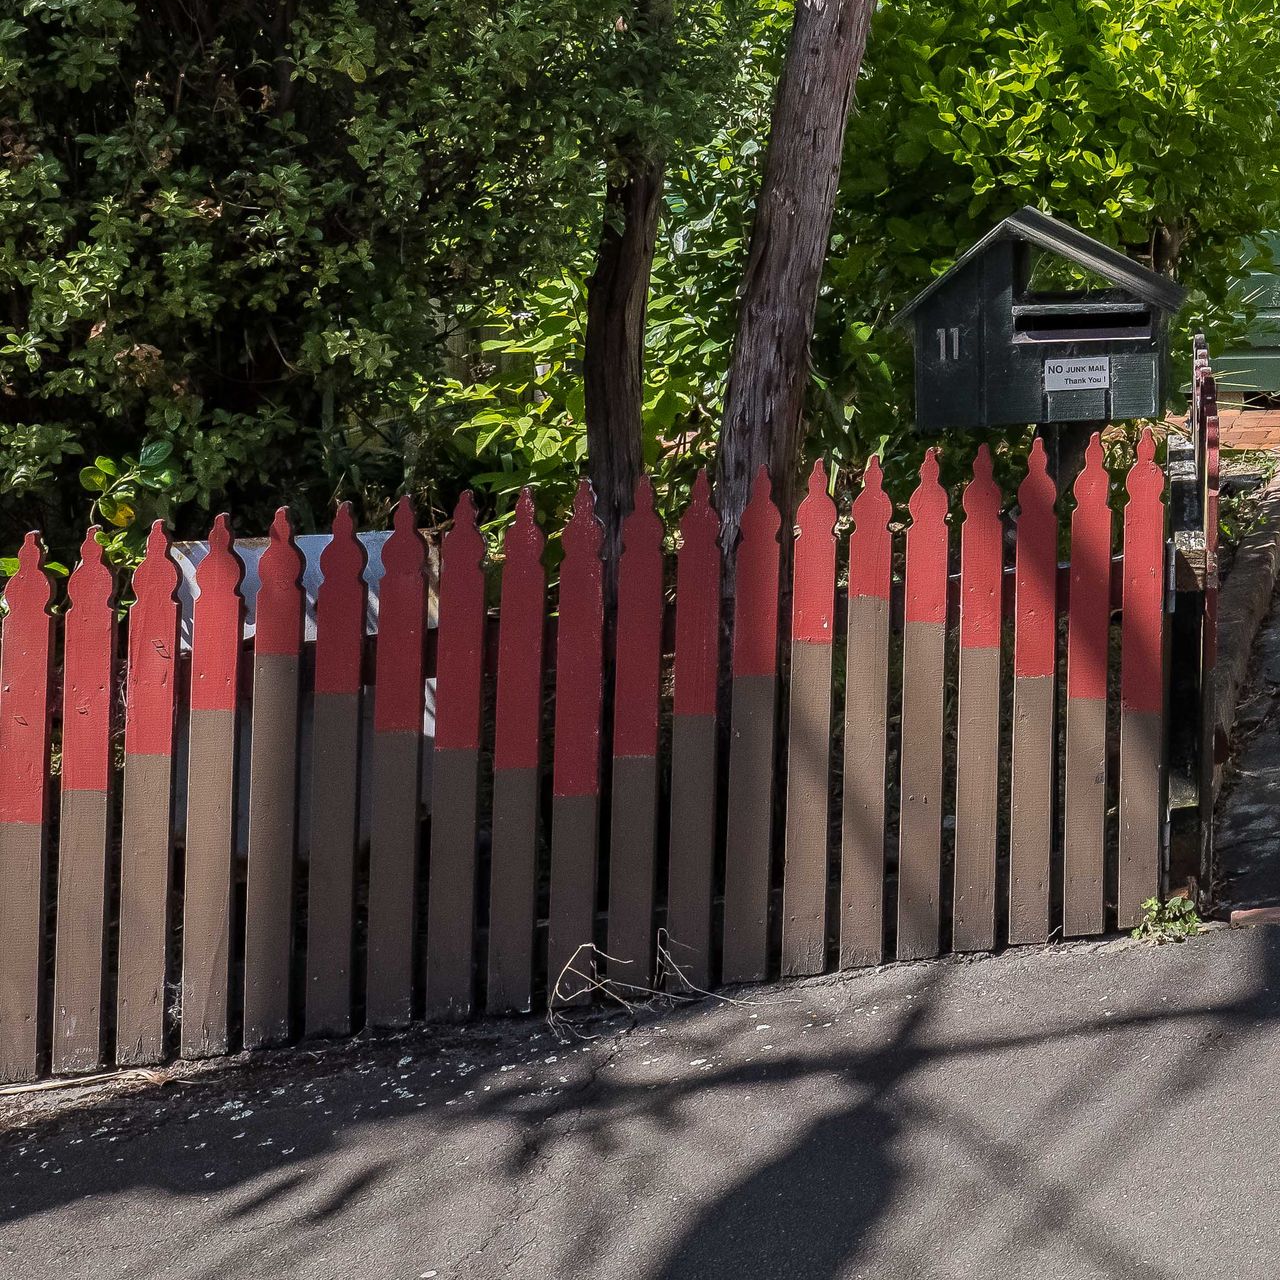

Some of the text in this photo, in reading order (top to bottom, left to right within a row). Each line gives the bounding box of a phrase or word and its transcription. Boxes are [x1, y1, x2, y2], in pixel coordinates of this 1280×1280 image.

[936, 327, 959, 360] 11
[1048, 365, 1064, 374] NO
[1066, 365, 1087, 374] JUNK
[1064, 377, 1087, 385] Thank
[1088, 376, 1102, 384] You
